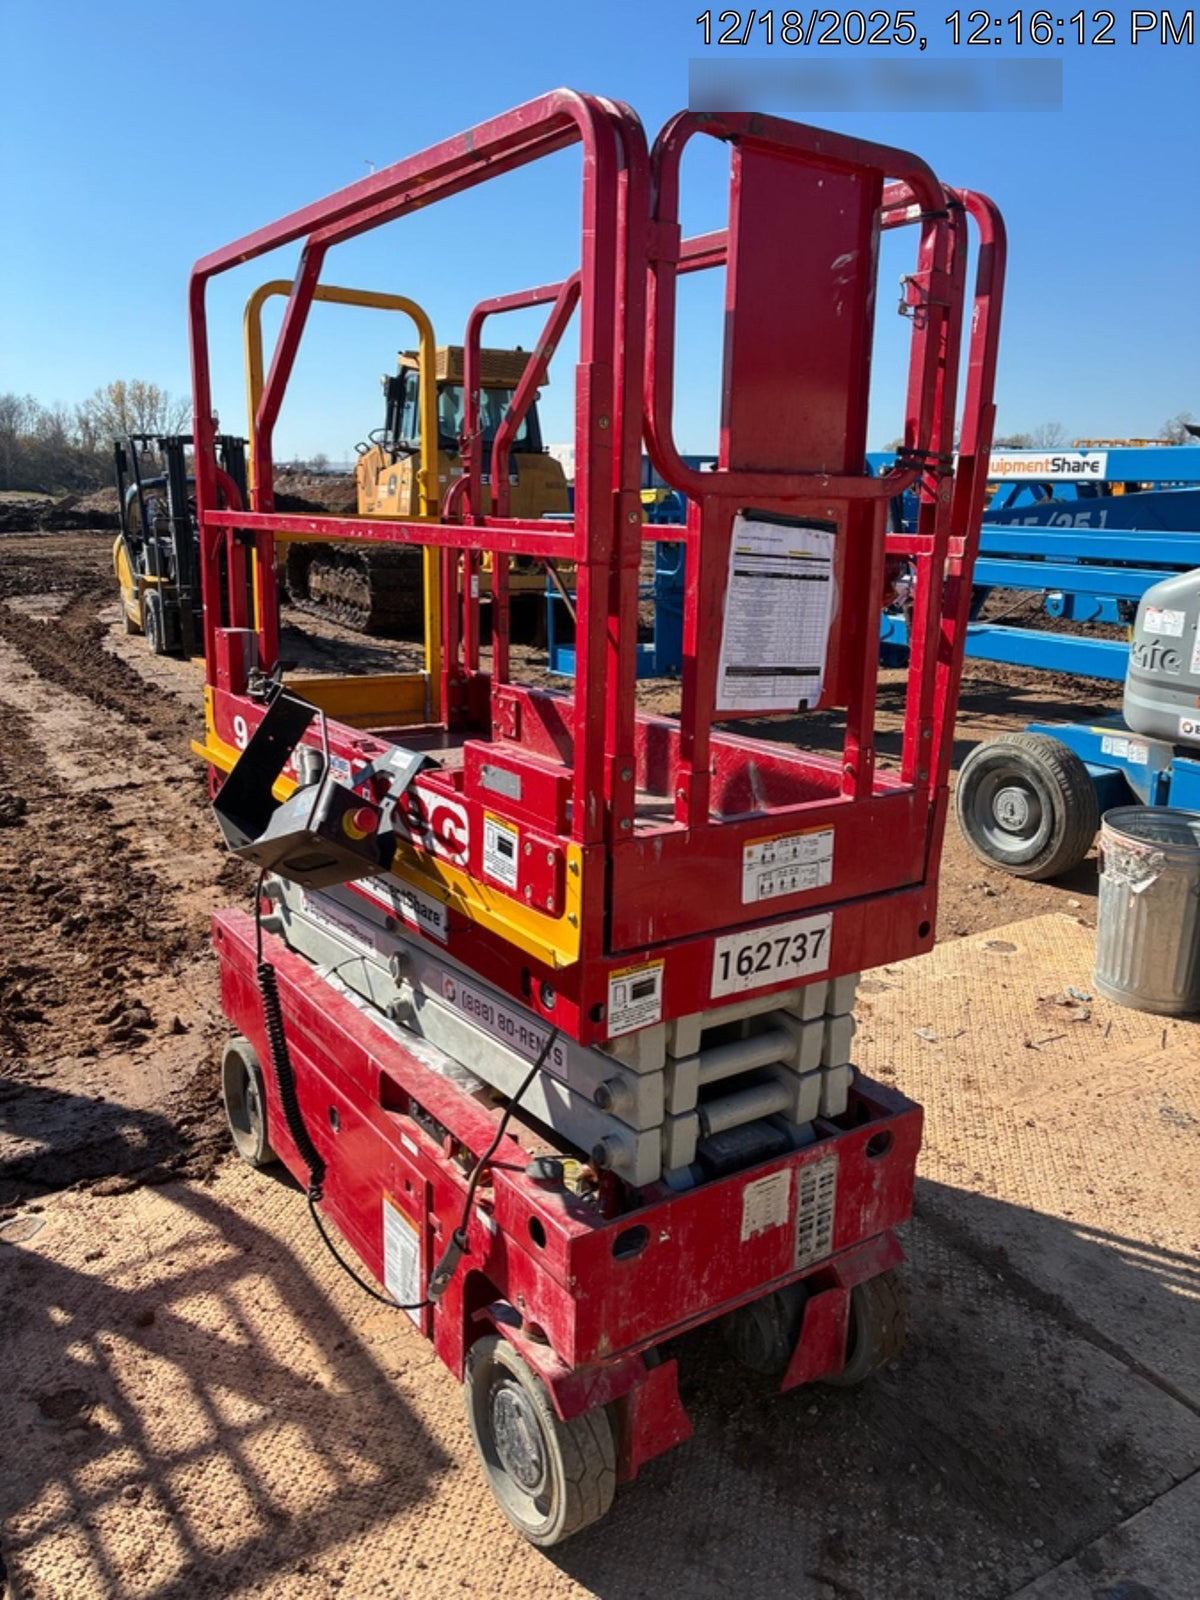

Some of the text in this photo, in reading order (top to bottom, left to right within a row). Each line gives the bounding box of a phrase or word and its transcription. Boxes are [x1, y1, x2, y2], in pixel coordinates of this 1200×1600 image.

[990, 457, 1100, 475] uipmentShare
[719, 928, 826, 981] 162737
[461, 989, 563, 1067] (888) 80-RENS
